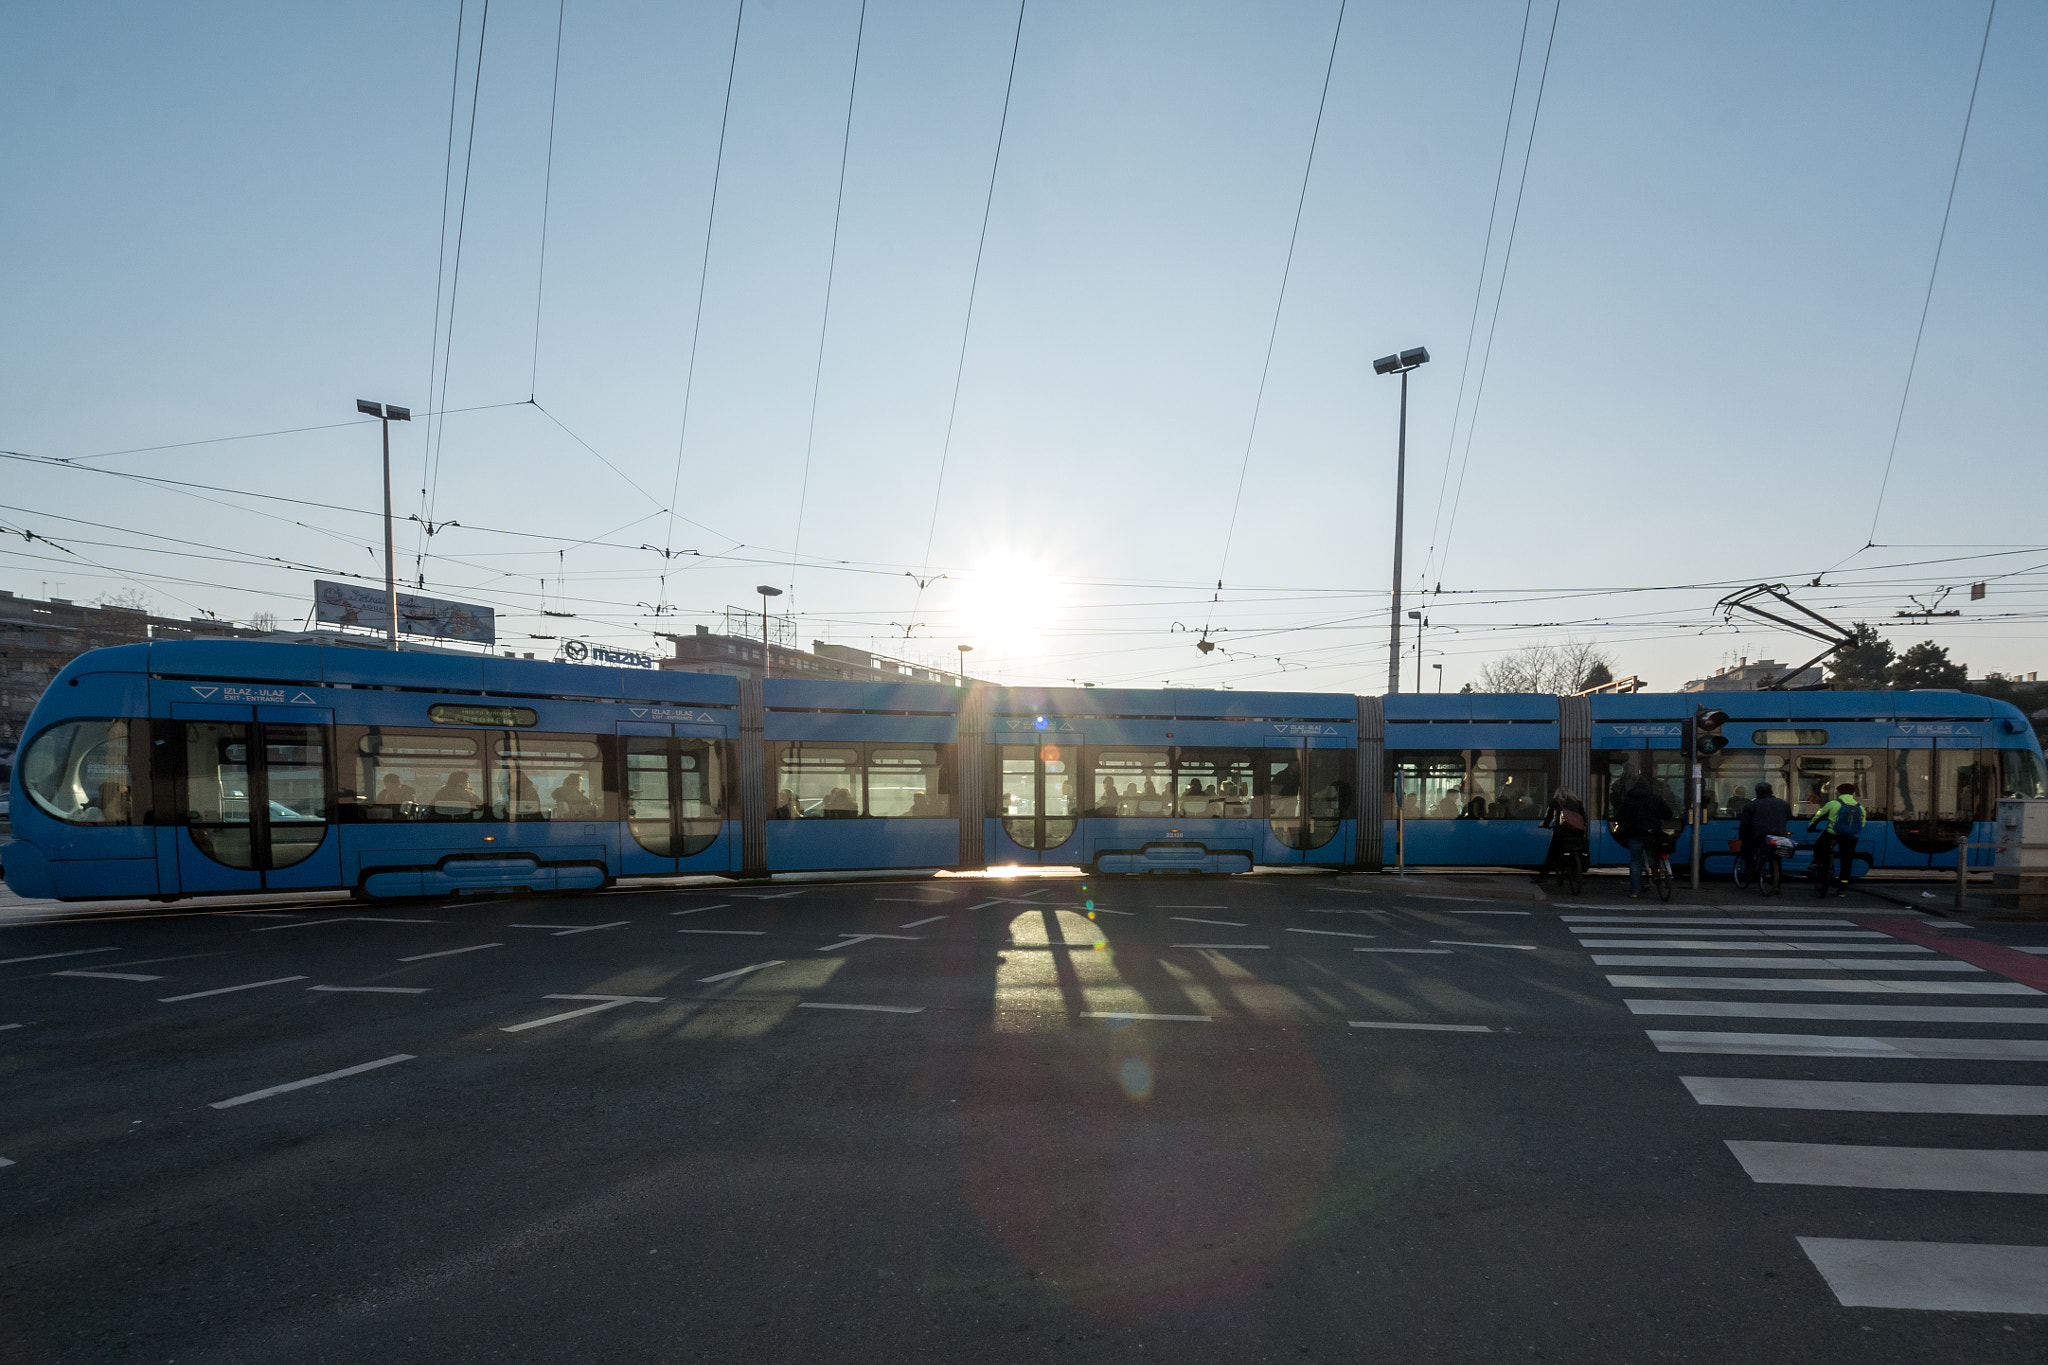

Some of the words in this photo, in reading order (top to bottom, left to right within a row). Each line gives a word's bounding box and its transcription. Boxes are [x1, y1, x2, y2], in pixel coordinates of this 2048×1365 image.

[593, 648, 652, 668] mazda
[223, 687, 252, 696] IZLAZ
[259, 689, 285, 697] ULAZ
[246, 695, 285, 703] ENTRANCE
[651, 708, 671, 716] IZLAZ
